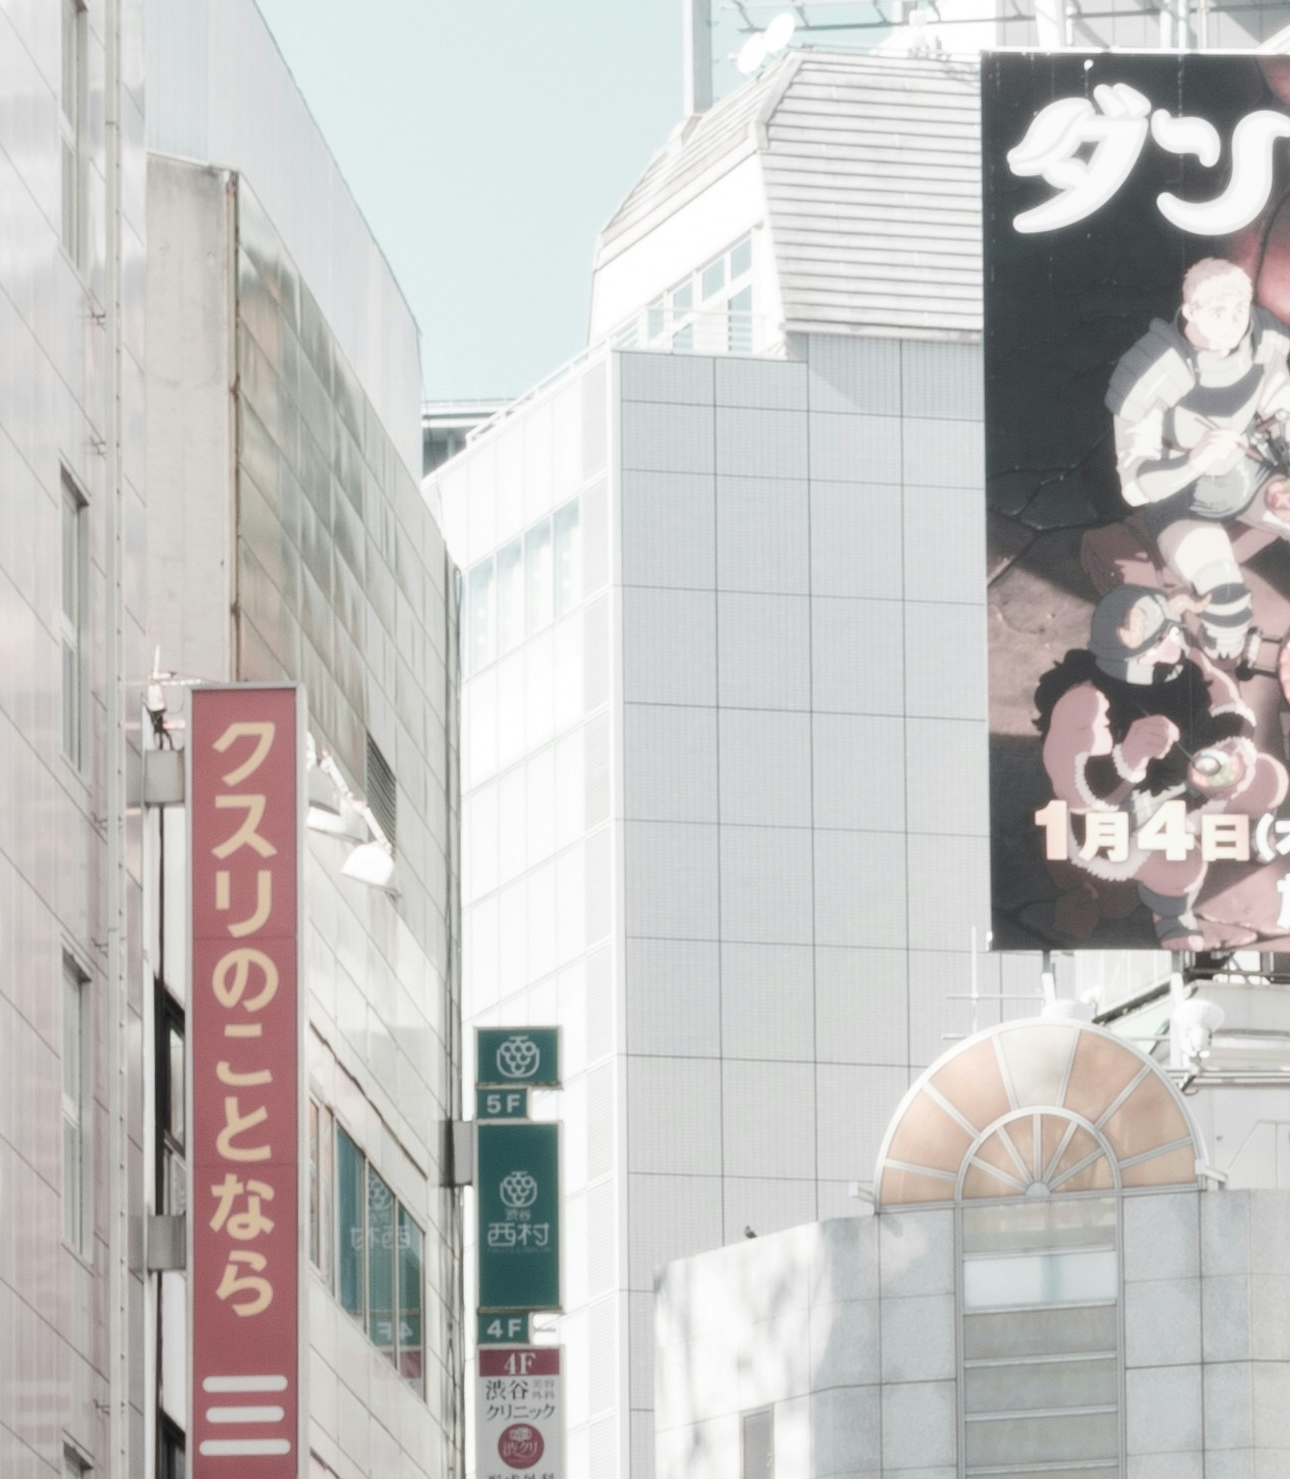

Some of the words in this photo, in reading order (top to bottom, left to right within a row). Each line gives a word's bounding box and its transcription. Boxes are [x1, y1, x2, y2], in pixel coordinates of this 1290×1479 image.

[210, 720, 280, 1319] クスリのことなら
[486, 1093, 521, 1115] 5F
[487, 1223, 550, 1249] 西村
[486, 1319, 522, 1339] 4F
[503, 1352, 536, 1376] 4F
[487, 1404, 556, 1421] クリニック
